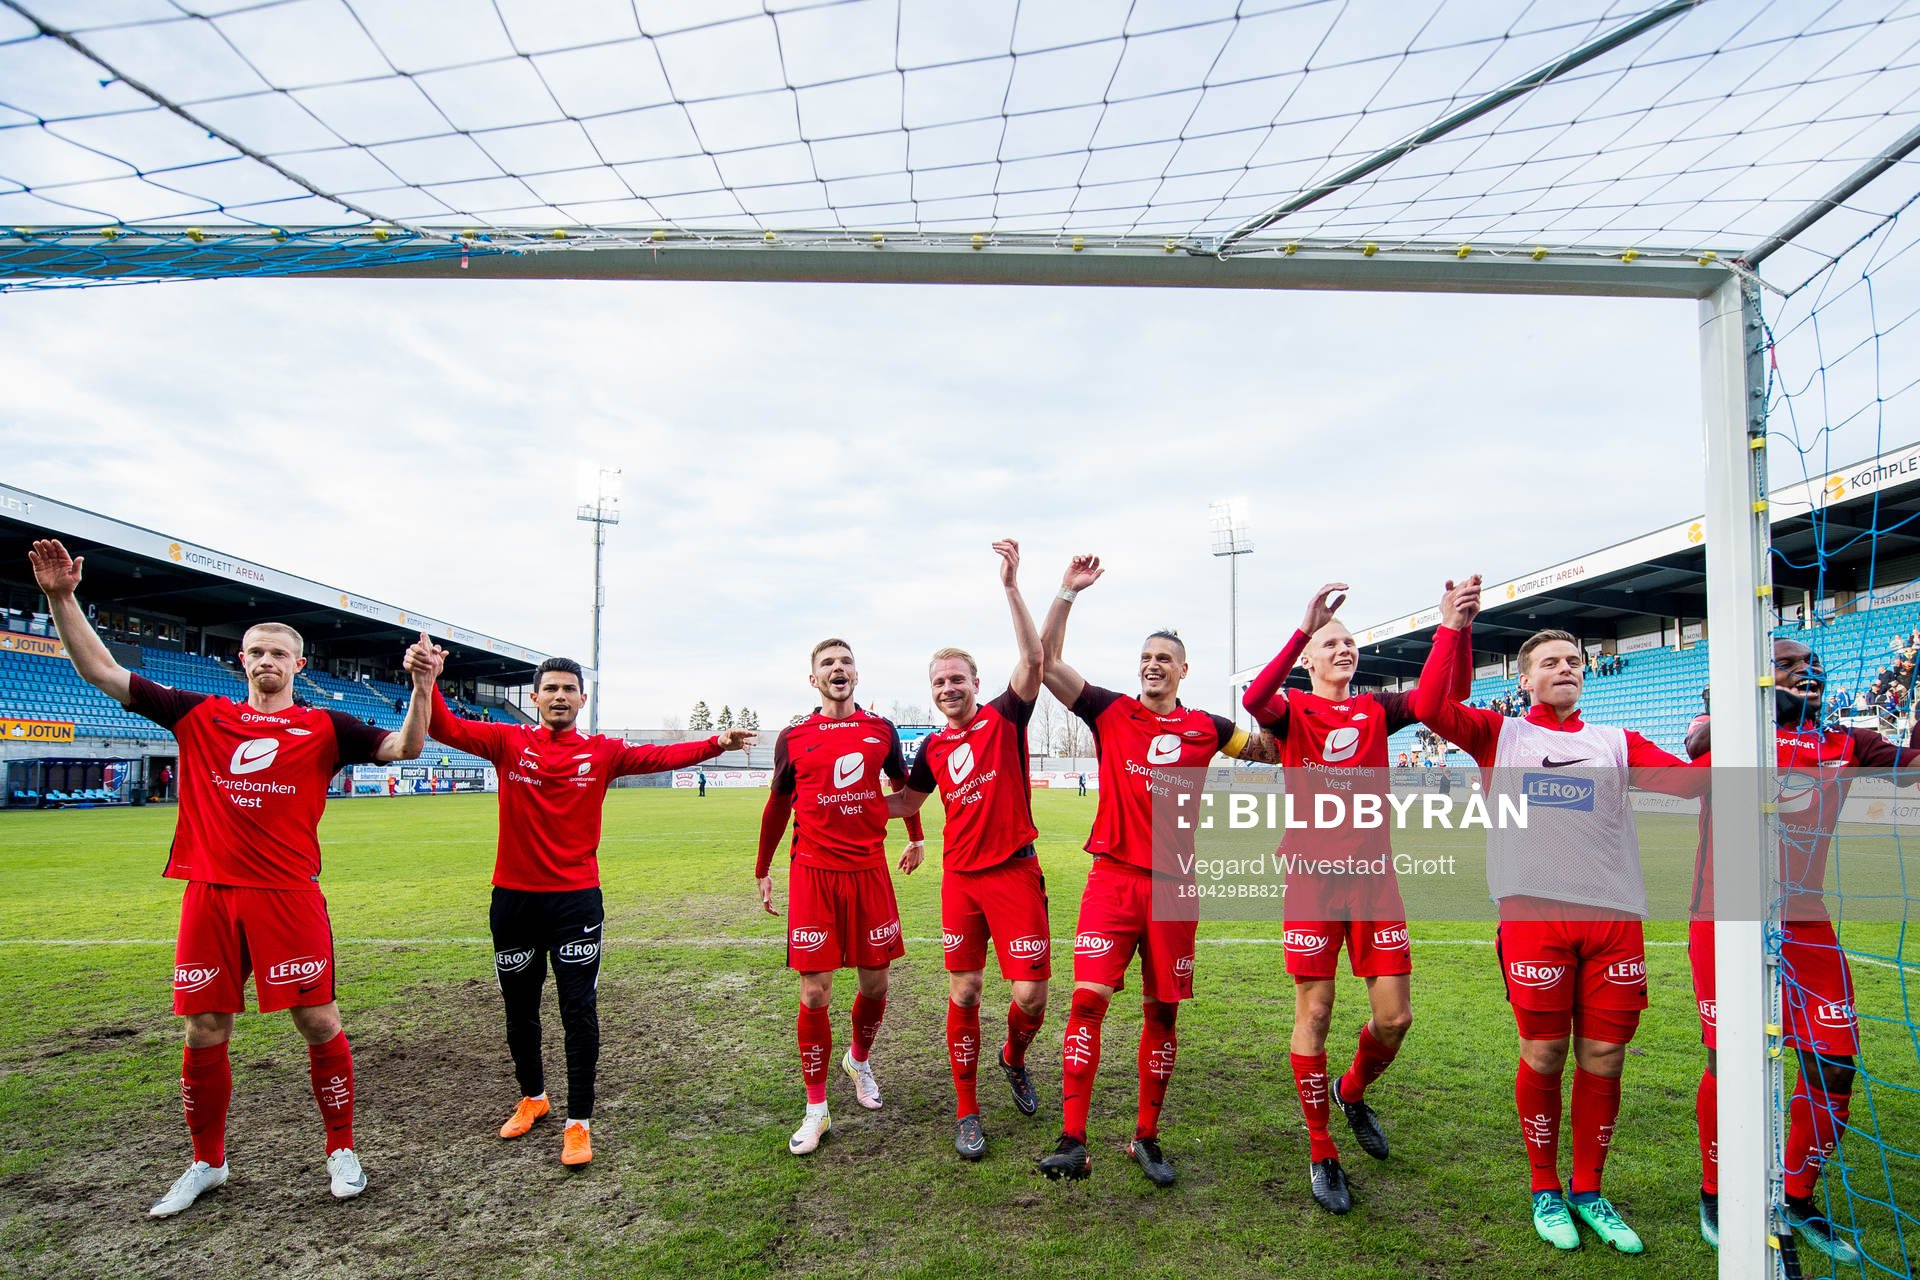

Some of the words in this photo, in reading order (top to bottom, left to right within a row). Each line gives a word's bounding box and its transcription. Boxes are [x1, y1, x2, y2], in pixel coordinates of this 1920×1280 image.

[1851, 455, 1920, 489] KOMPLE
[185, 551, 233, 572] KOMPLETT
[236, 566, 265, 583] ARENA
[1517, 575, 1553, 594] KOMPLETT
[1556, 565, 1585, 583] ARENA
[350, 601, 379, 616] KOMPLETT
[15, 637, 55, 654] JOTUN
[26, 724, 71, 739] JOTUN
[519, 756, 539, 770] bob
[1302, 757, 1376, 778] Sparebanken
[211, 770, 297, 794] Sparebanken
[1125, 759, 1195, 790] Sparebanken
[1145, 780, 1170, 797] Vest
[1325, 778, 1353, 790] Vest
[1528, 781, 1589, 799] LERØY
[230, 794, 263, 808] Vest
[817, 789, 877, 806] Sparebanke
[1637, 798, 1681, 808] KOMPLETT
[840, 804, 863, 816] Vest
[869, 919, 900, 941] LERØY
[1010, 938, 1047, 952] LERØY
[174, 967, 215, 983] ERØY
[270, 959, 323, 979] LERØY
[1511, 962, 1562, 980] LERØY
[954, 1035, 975, 1067] tide
[803, 1044, 824, 1077] tide
[1149, 1041, 1176, 1080] tide
[322, 1075, 350, 1110] tide
[1524, 1113, 1552, 1149] tide
